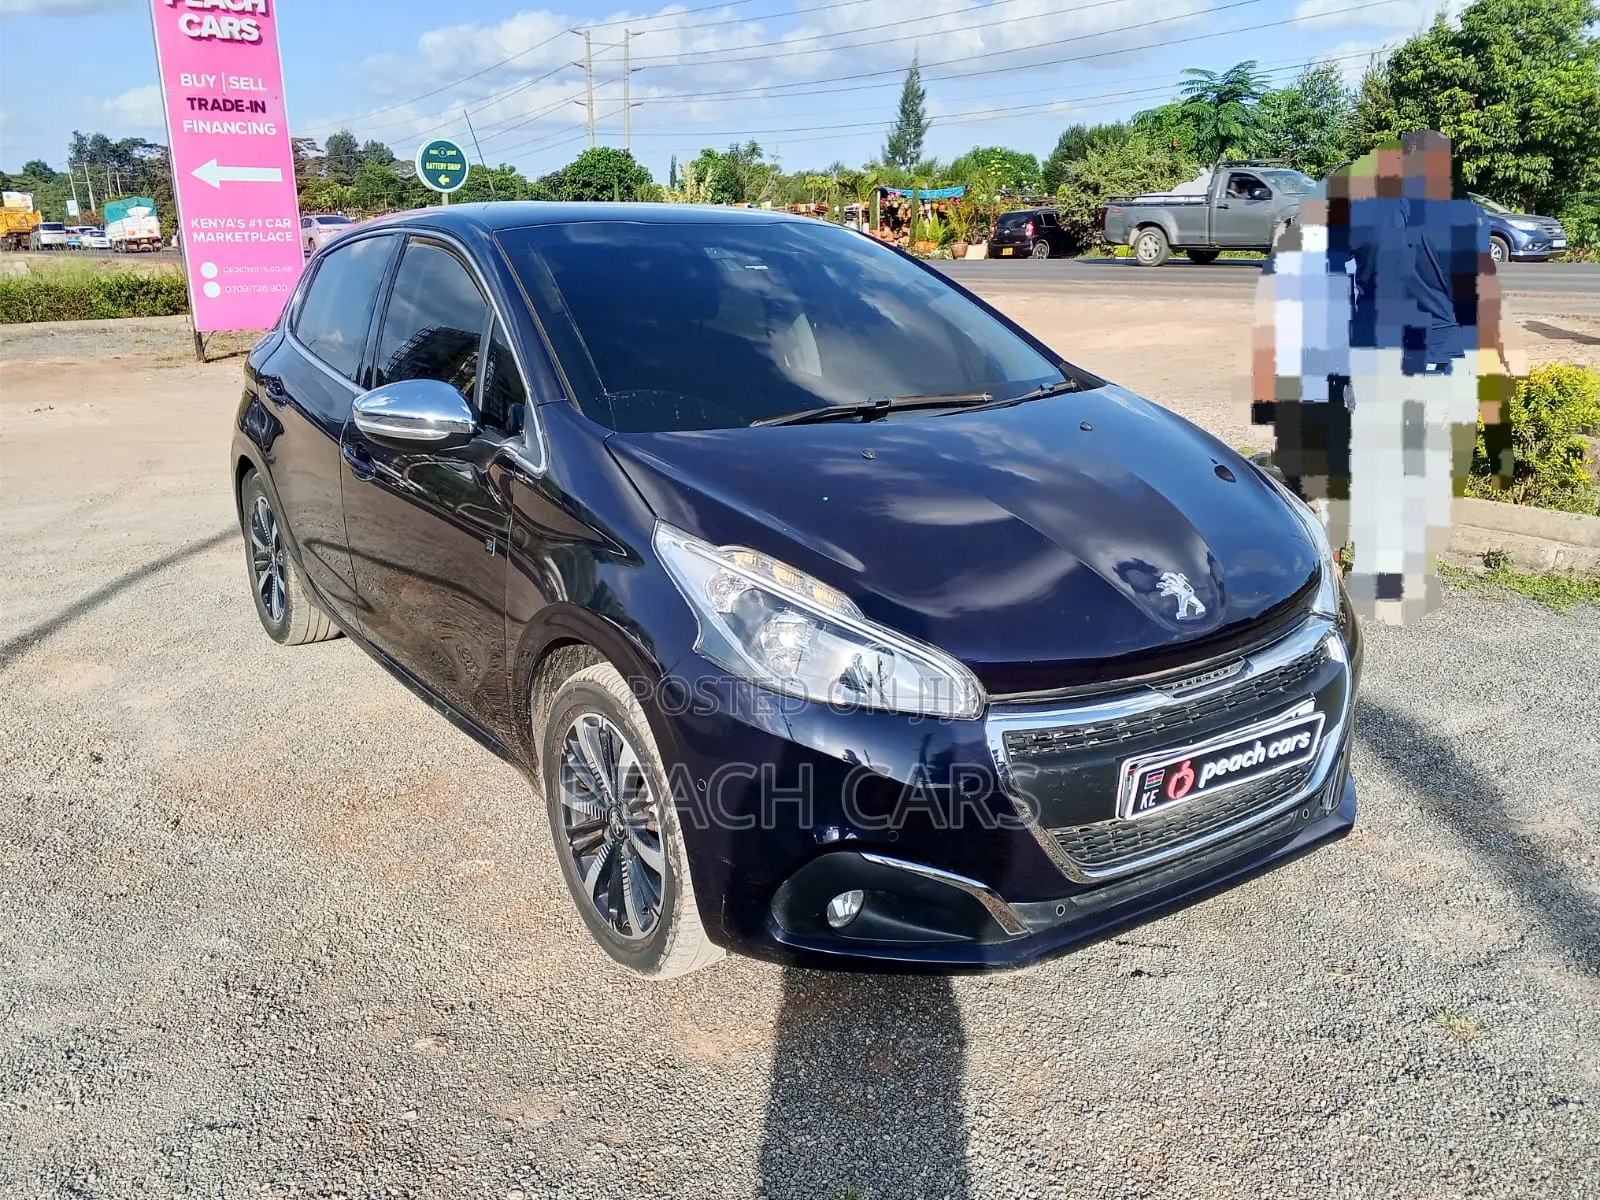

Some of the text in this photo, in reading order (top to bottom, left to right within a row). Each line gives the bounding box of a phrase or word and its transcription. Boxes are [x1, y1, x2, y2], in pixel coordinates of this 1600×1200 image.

[178, 13, 261, 43] CARS
[180, 73, 267, 91] BUY SELL
[187, 97, 266, 113] TRADE-IN
[183, 120, 277, 136] FINANCING
[191, 218, 292, 229] KENYA'S #1 CAR
[192, 231, 294, 242] MARKETPLACE
[1198, 731, 1312, 789] peach cars
[1140, 788, 1160, 810] KE
